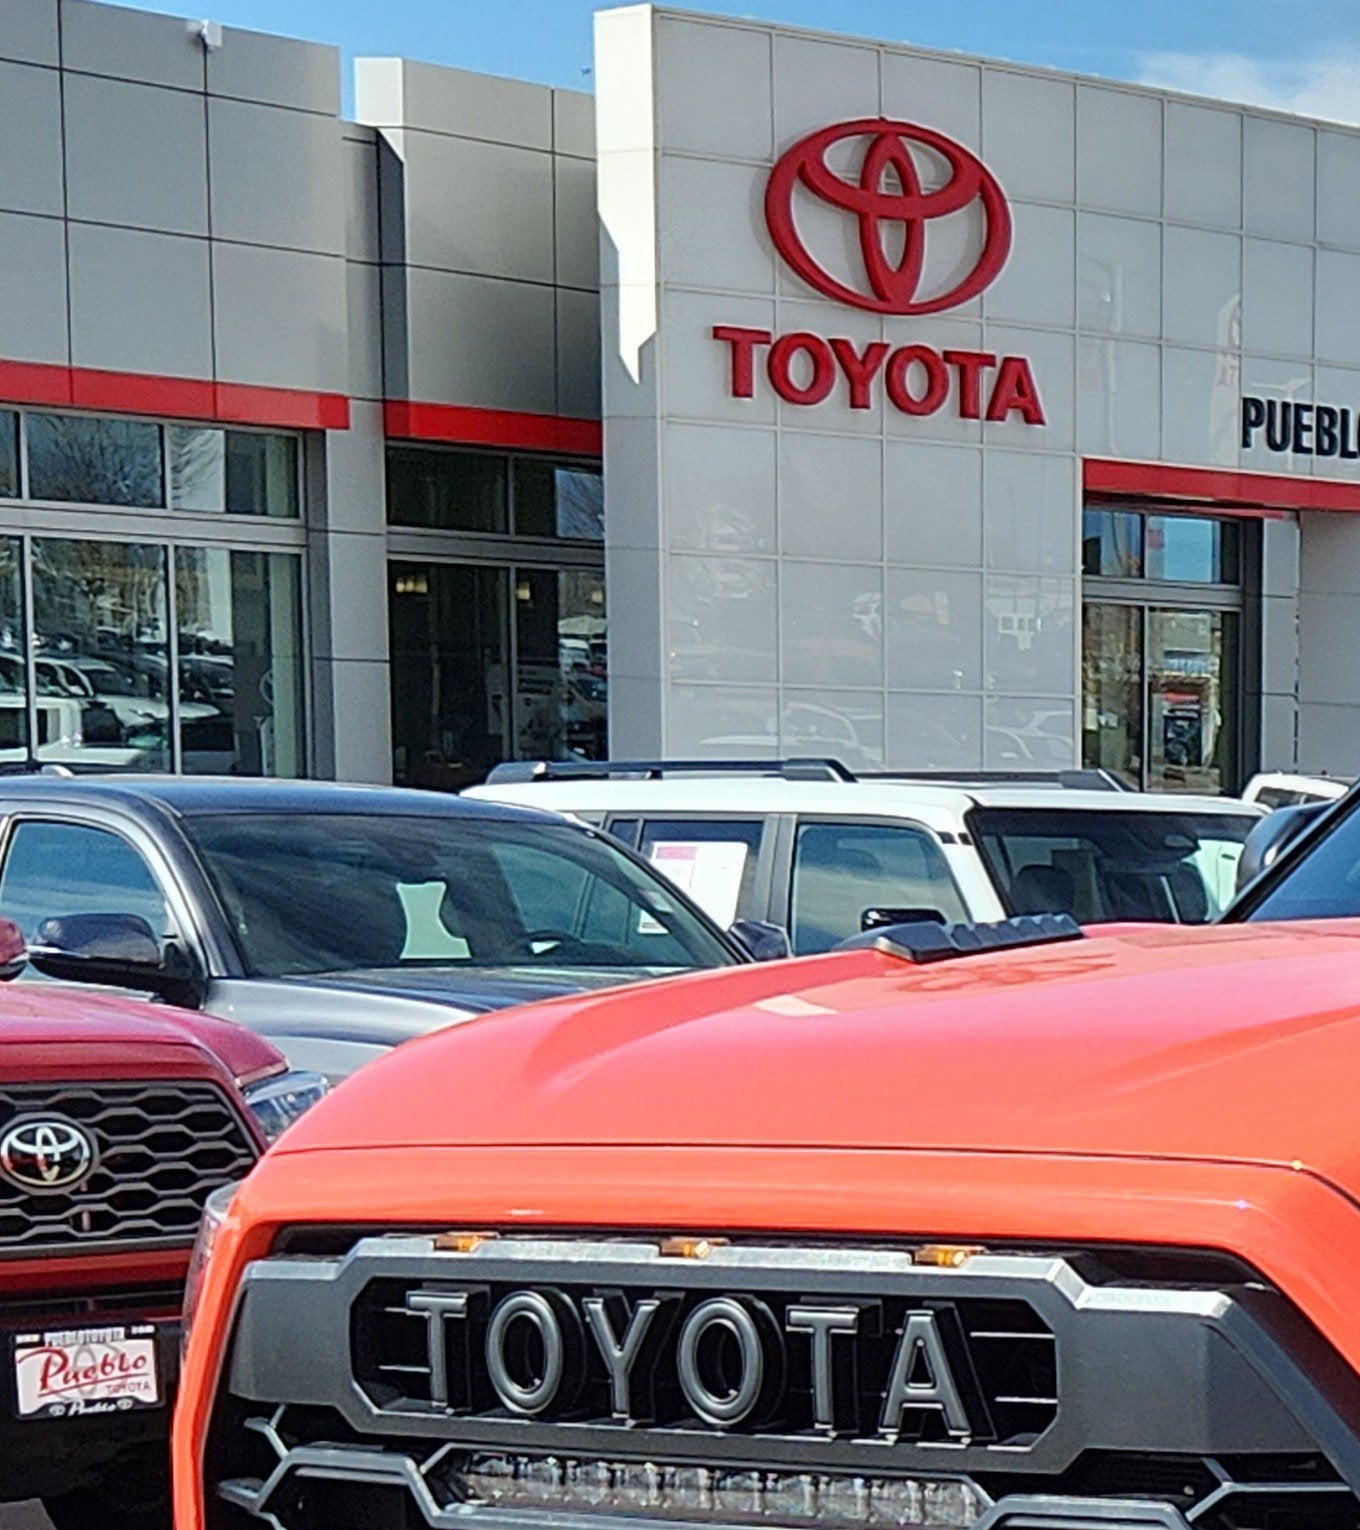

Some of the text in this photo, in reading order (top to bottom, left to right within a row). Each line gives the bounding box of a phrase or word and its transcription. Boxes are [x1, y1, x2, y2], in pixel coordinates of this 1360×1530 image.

[712, 325, 1046, 426] TOYOTA
[18, 1346, 147, 1391] Pueblo
[405, 1285, 985, 1448] TOYOTA
